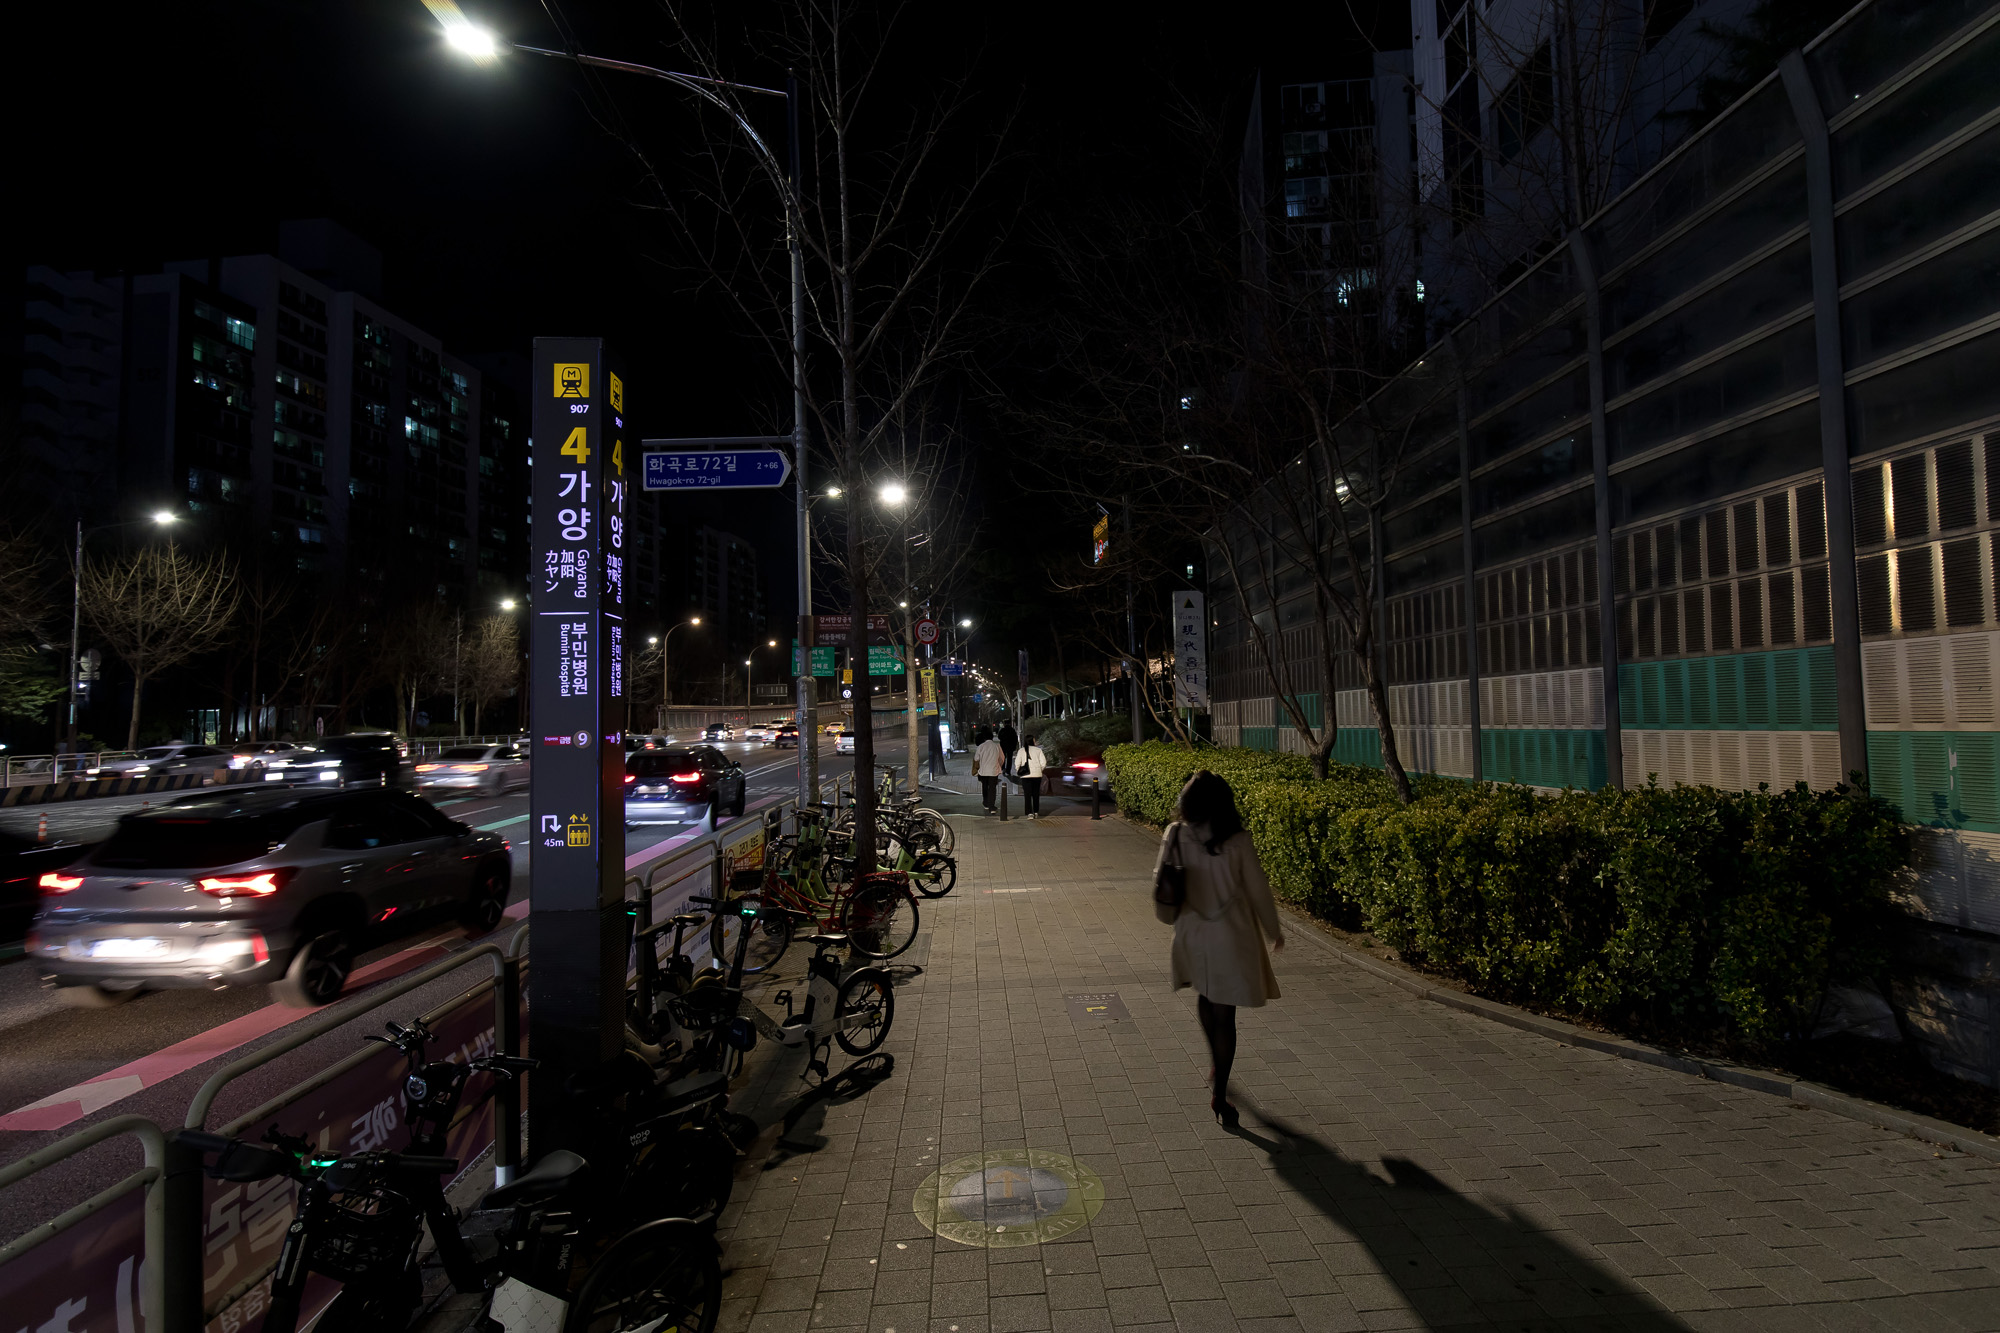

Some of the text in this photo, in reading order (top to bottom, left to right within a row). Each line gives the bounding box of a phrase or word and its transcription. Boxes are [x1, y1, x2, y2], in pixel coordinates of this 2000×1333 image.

[570, 404, 590, 414] 907
[560, 427, 591, 464] 4
[612, 439, 624, 476] 4
[649, 455, 737, 473] 화곡로72길
[649, 475, 721, 487] Hwagok-ro 72-gil
[557, 470, 592, 541] 가양
[610, 480, 624, 548] 가양
[545, 550, 560, 593] カヤン
[560, 550, 575, 579] 加阳
[574, 549, 590, 598] Gayang
[921, 626, 934, 637] 50
[558, 623, 571, 697] Bumin Hospital
[571, 622, 589, 695] 부민병원
[578, 732, 588, 746] 9
[543, 838, 564, 848] 45m
[557, 1243, 571, 1271] SWING
